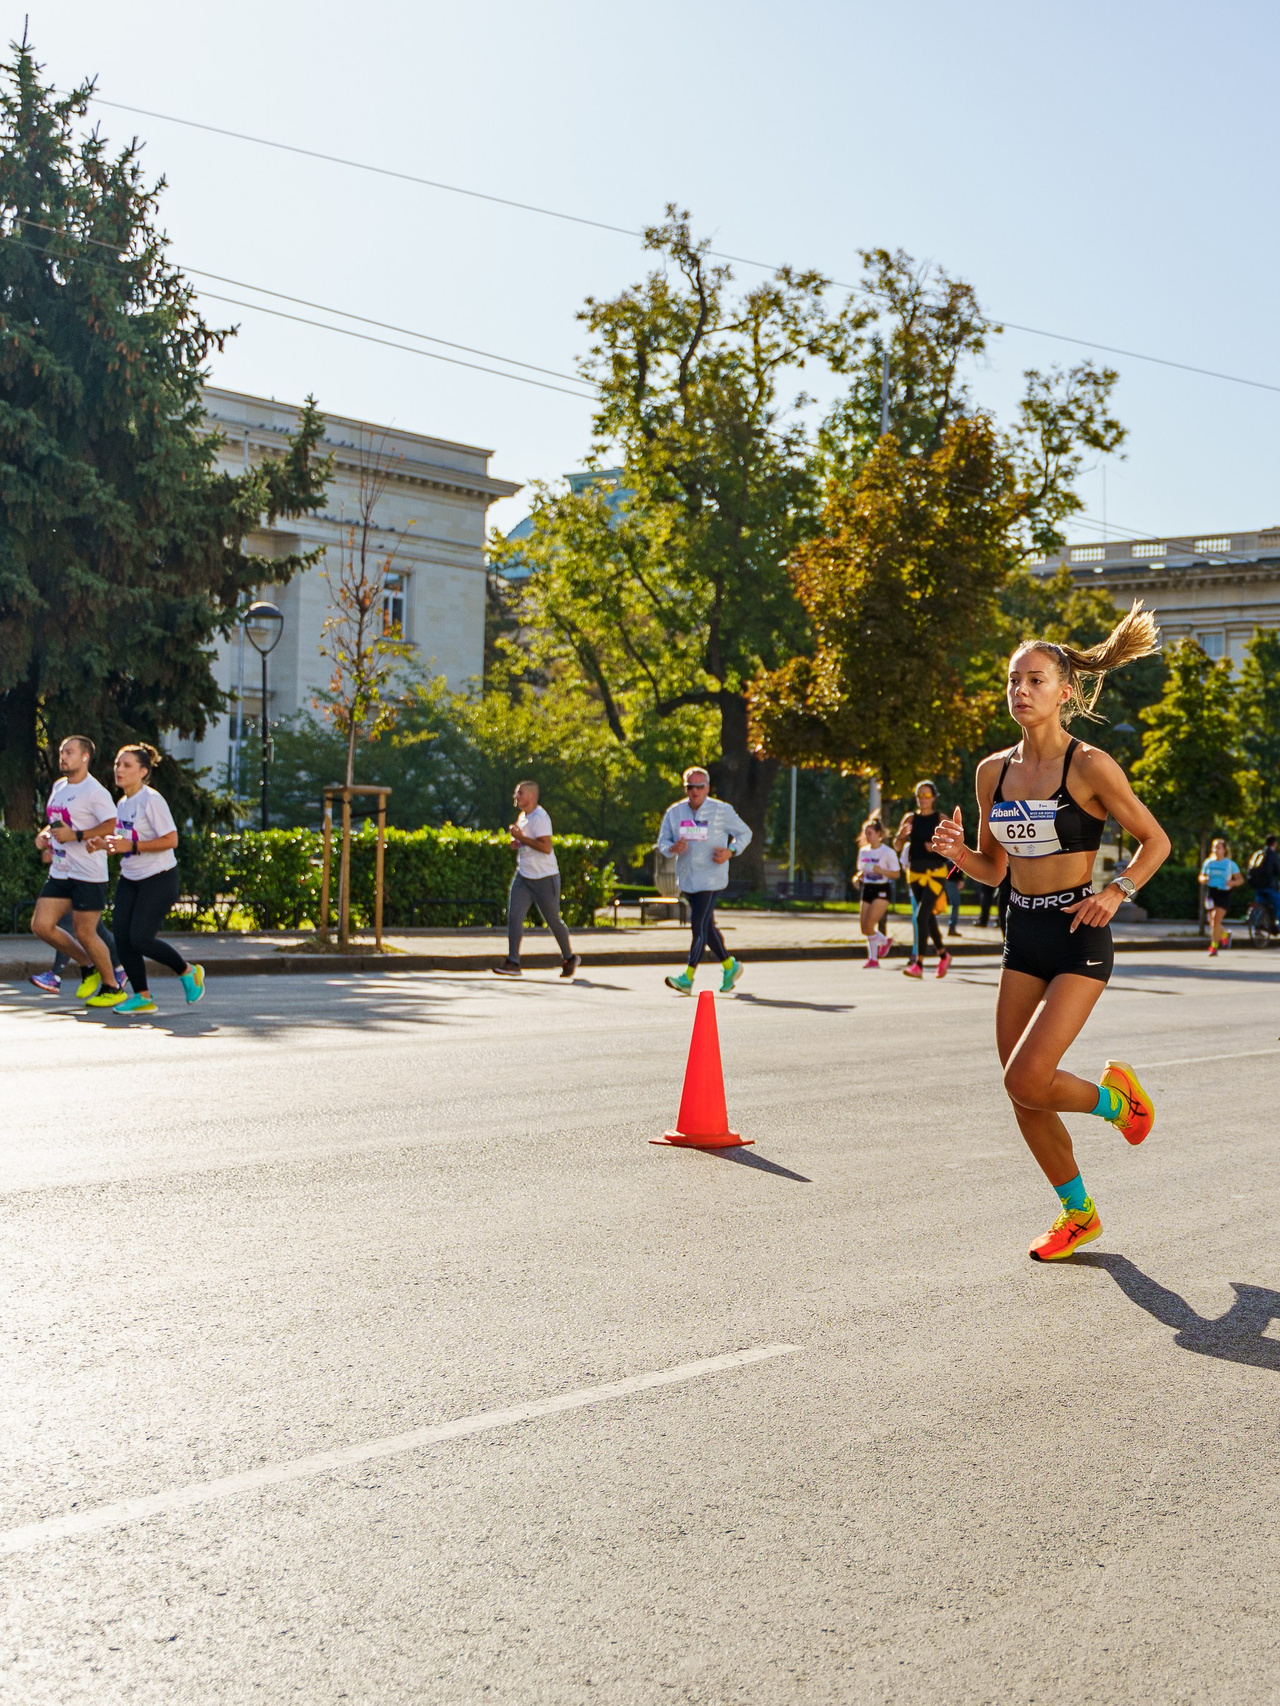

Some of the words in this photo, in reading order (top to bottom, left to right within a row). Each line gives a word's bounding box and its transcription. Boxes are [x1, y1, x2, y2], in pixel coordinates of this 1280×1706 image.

[991, 807, 1020, 818] Fibank
[1006, 823, 1037, 839] 626
[1032, 892, 1075, 910] PRO
